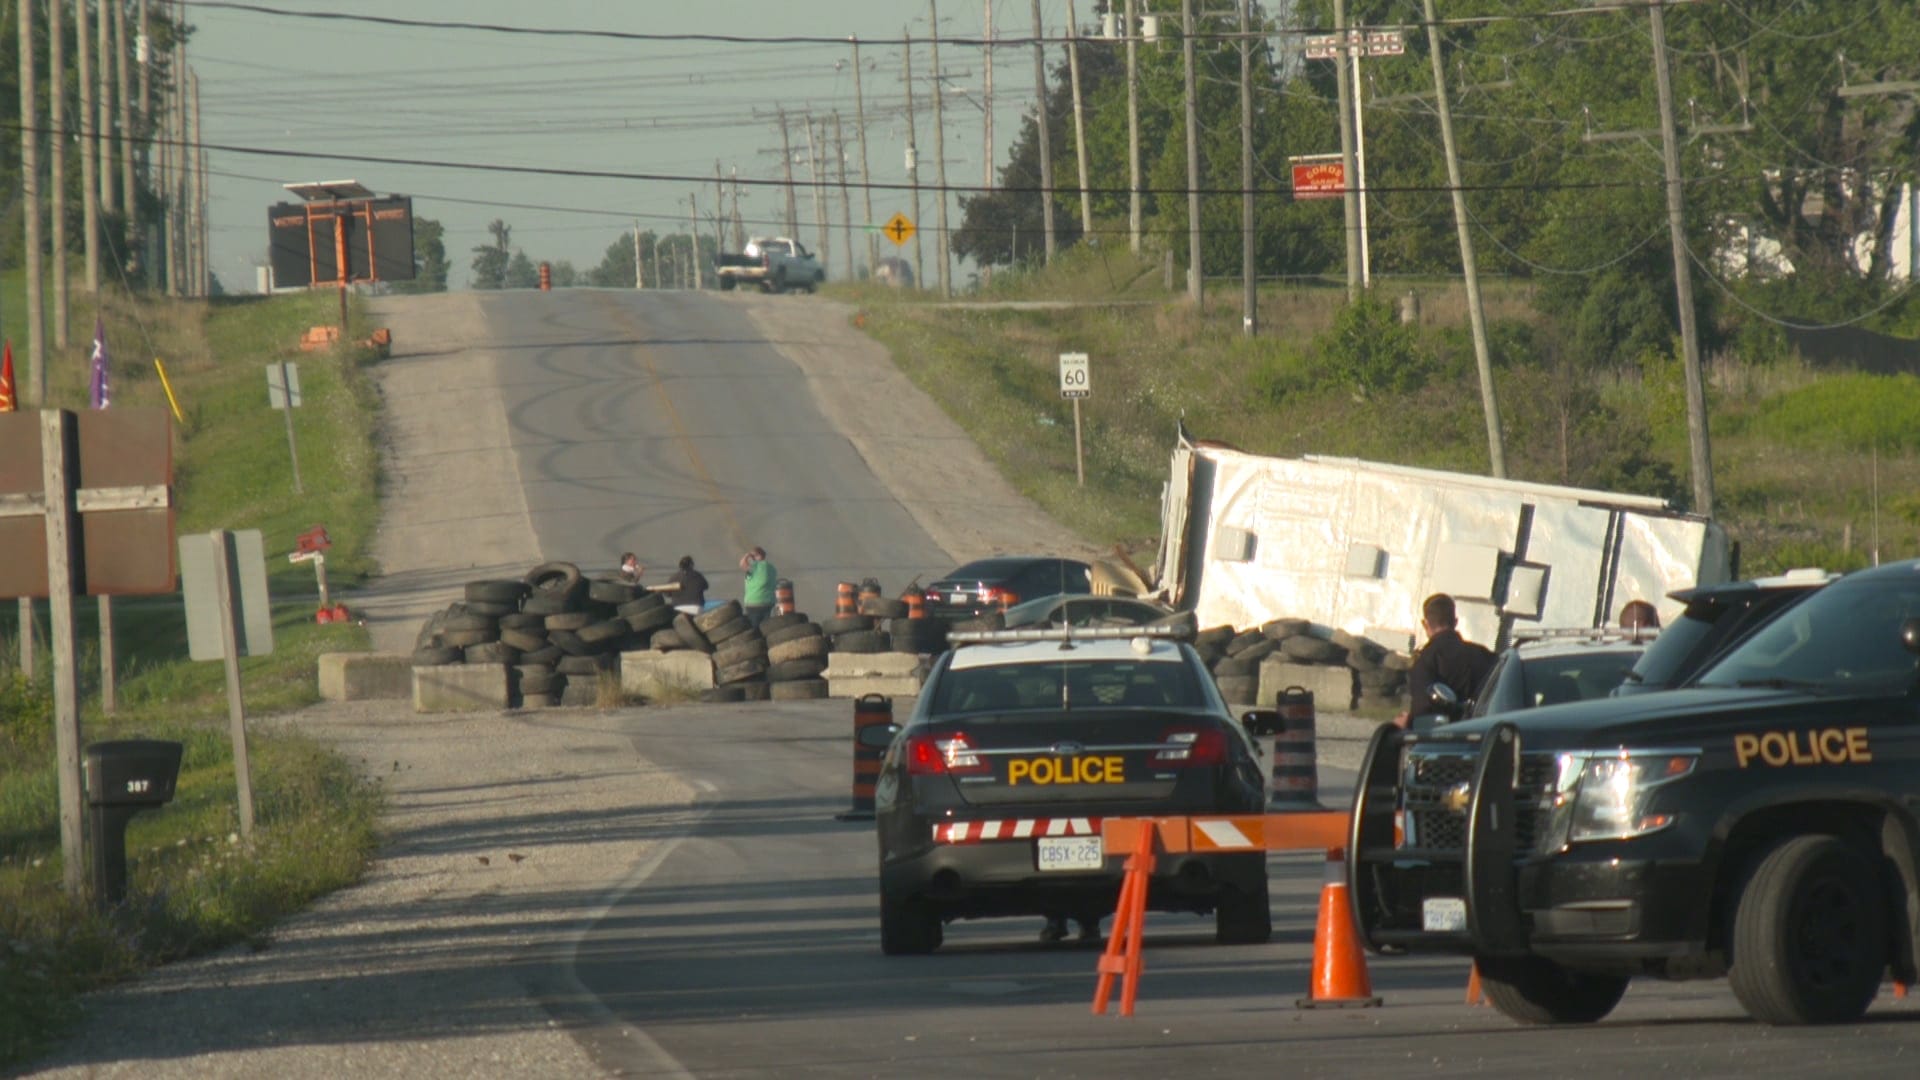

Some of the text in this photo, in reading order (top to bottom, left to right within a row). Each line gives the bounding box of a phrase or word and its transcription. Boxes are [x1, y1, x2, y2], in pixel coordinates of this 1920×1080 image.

[1065, 368, 1086, 386] 60
[1734, 727, 1873, 769] POLICE
[1008, 757, 1125, 785] POLICE
